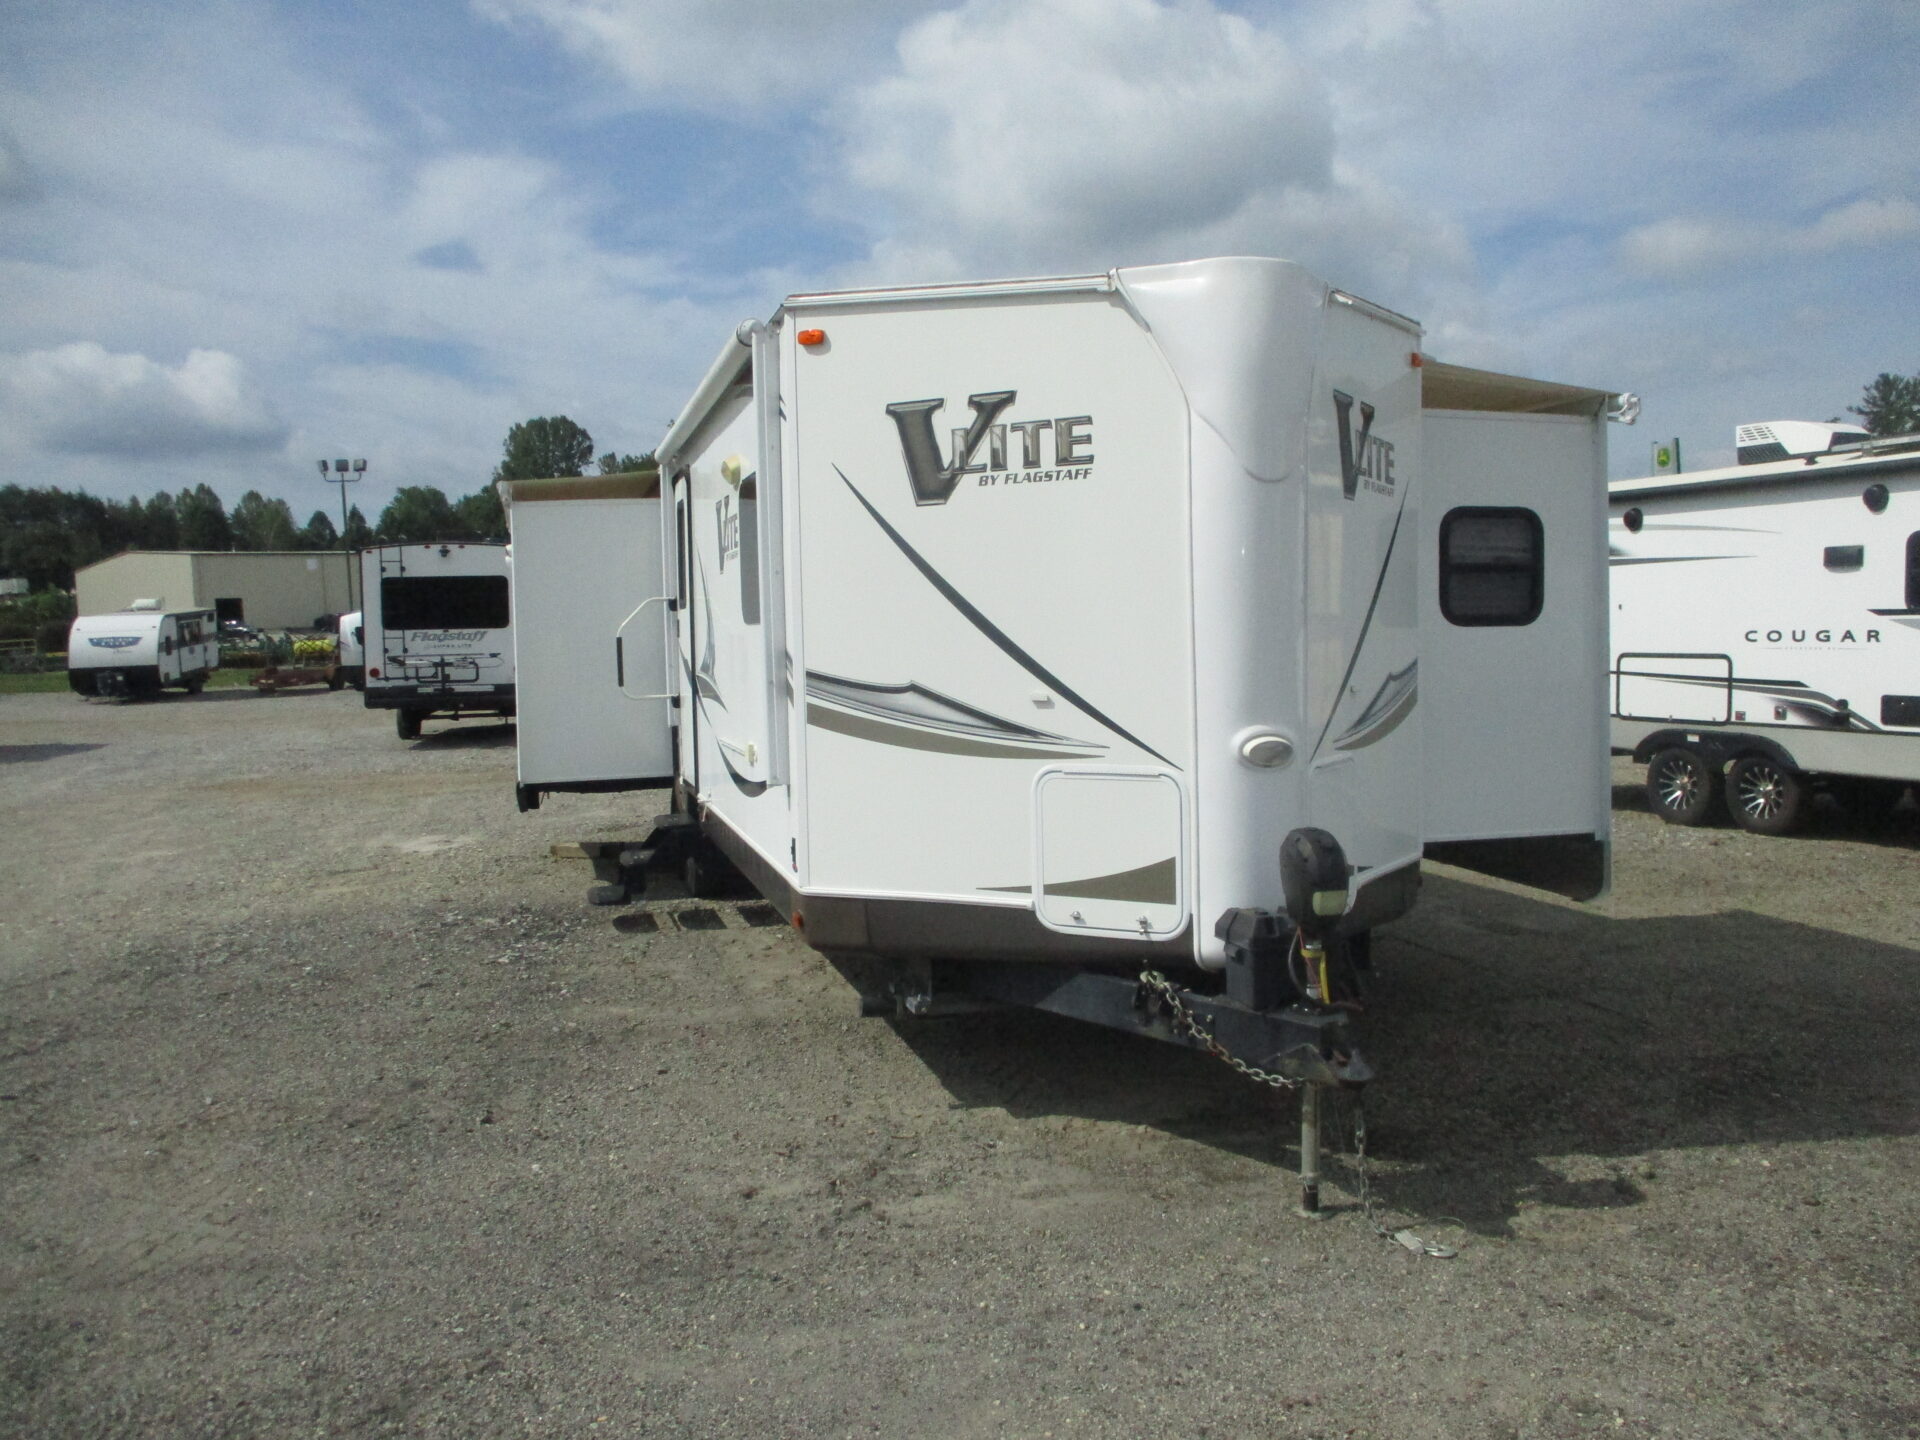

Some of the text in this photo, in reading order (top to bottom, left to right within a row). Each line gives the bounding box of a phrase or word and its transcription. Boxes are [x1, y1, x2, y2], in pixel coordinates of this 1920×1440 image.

[978, 467, 1093, 487] BY FLAGSTAFF
[410, 631, 488, 643] Flagstaff
[1744, 629, 1881, 643] COUGAR
